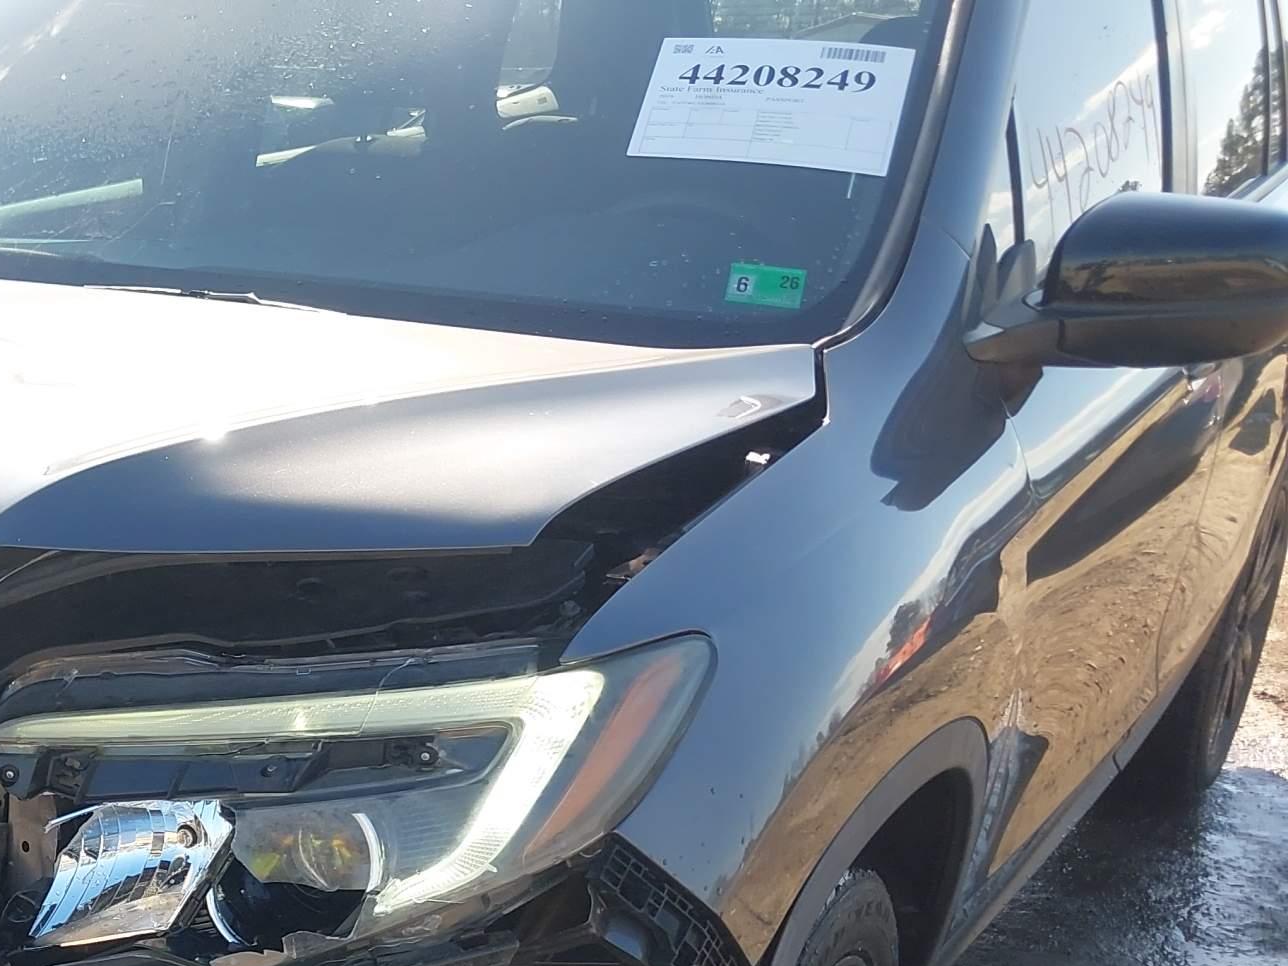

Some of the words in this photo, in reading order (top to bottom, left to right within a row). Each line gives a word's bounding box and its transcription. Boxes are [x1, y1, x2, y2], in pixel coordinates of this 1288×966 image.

[678, 63, 877, 93] 44208249
[659, 85, 685, 93] State
[687, 85, 713, 94] Farm
[715, 86, 765, 95] Insurance
[736, 276, 750, 293] 6
[779, 275, 801, 290] 26
